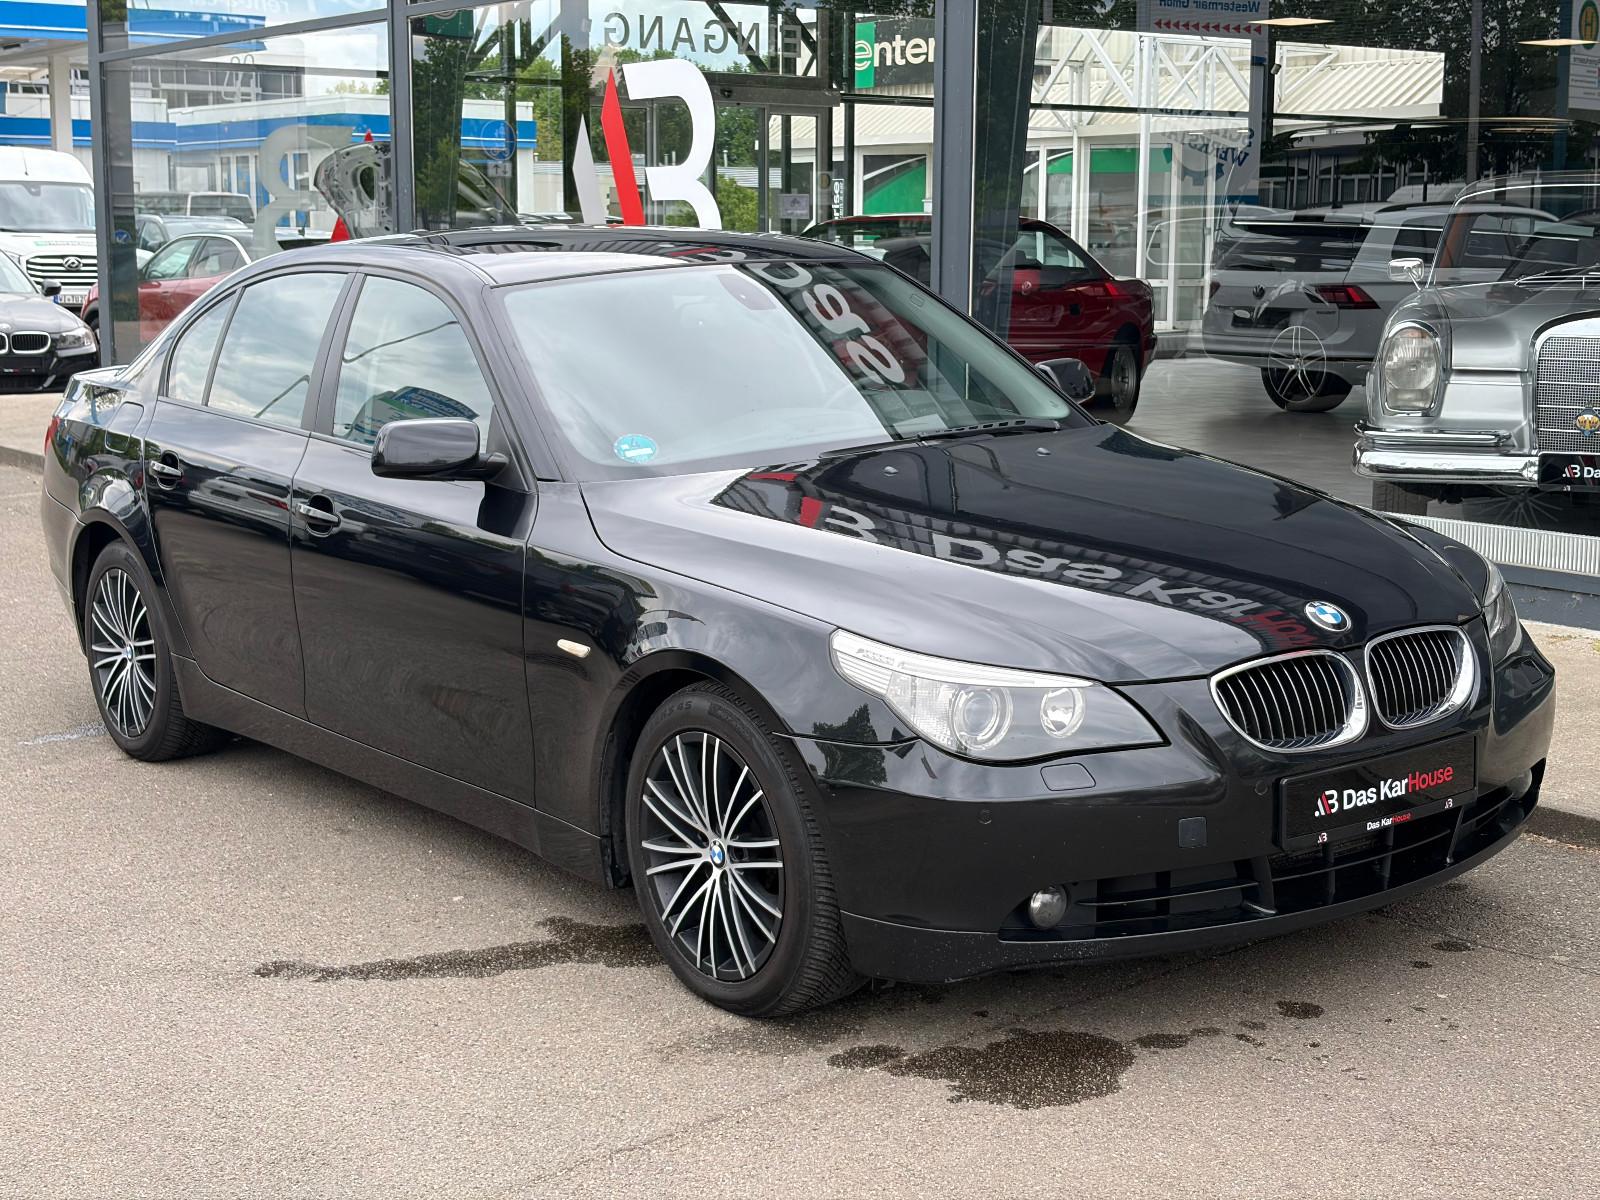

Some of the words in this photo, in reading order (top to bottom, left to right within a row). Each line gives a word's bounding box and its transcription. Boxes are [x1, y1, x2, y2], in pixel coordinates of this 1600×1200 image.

[1343, 786, 1377, 810] Das
[1380, 765, 1454, 801] KarHouse
[1366, 820, 1380, 831] Das
[1381, 812, 1411, 827] KarHouse
